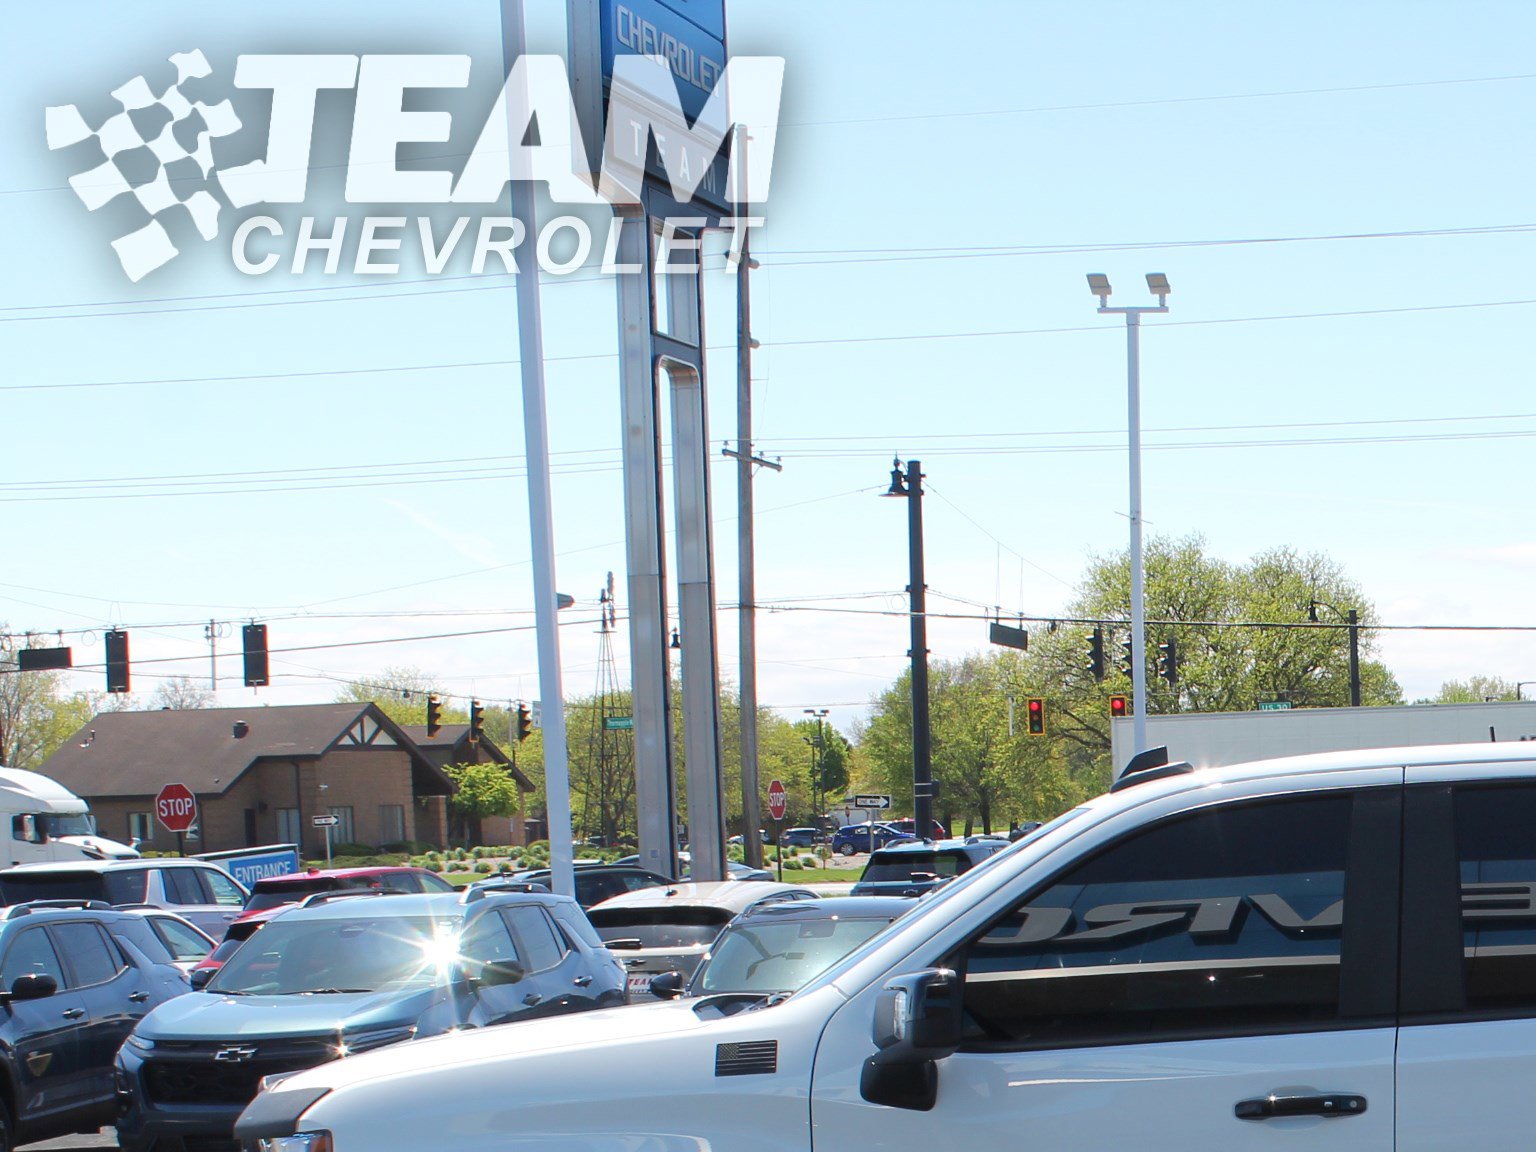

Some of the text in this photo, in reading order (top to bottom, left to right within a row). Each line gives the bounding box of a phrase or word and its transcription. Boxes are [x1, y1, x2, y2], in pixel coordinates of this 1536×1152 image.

[616, 4, 721, 97] CHEVROLET
[630, 120, 716, 194] TEAM
[159, 797, 193, 817] STOP
[769, 791, 785, 806] STOP
[235, 861, 291, 883] ENTRANCE
